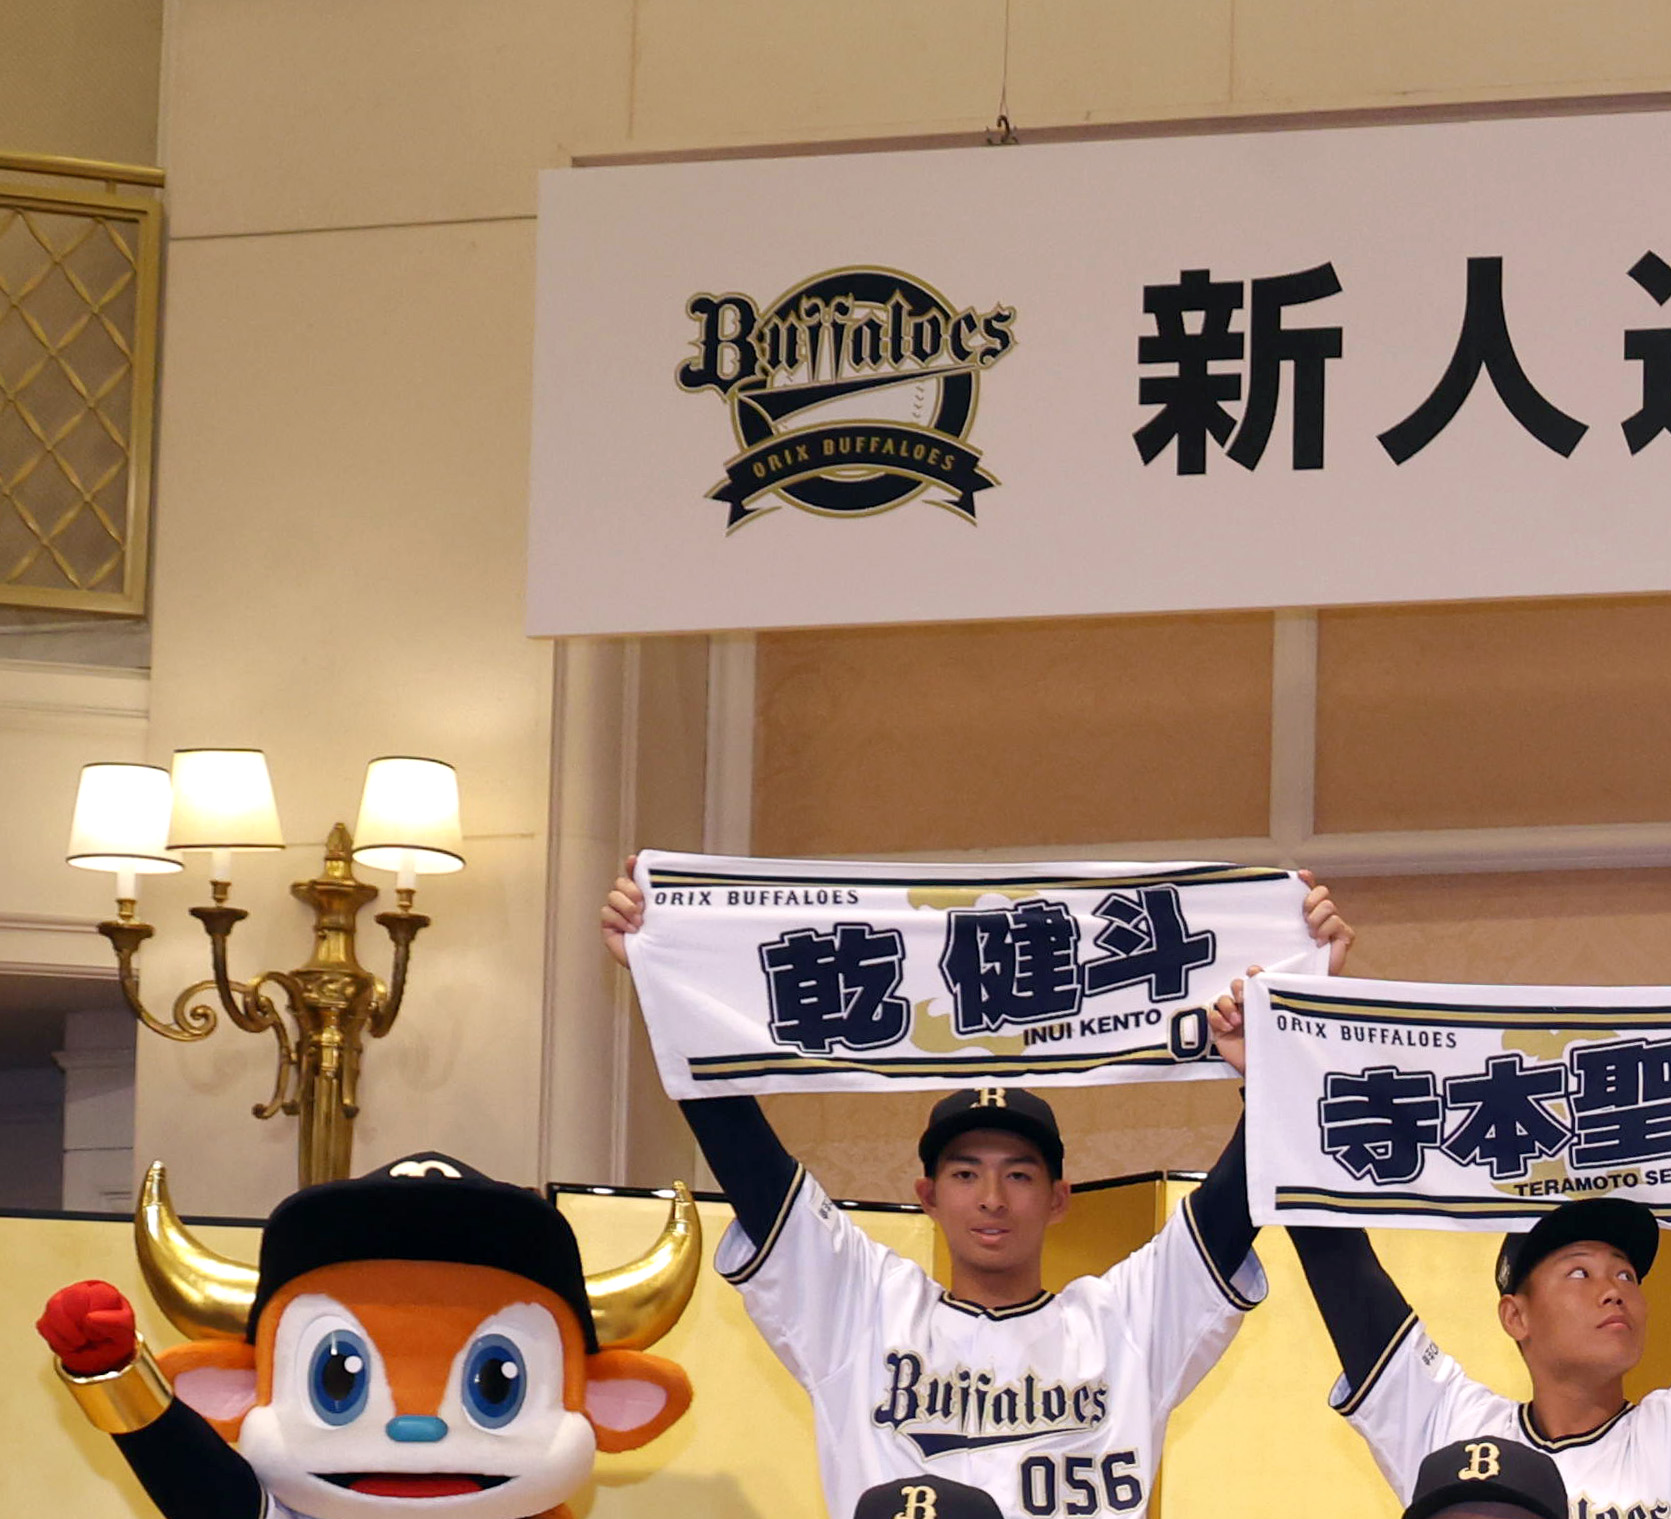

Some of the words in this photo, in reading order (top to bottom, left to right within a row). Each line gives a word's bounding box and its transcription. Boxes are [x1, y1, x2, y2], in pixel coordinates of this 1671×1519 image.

[675, 288, 1019, 404] Buffaloes
[752, 445, 810, 479] ORIX
[822, 435, 956, 471] BUFFALOES
[653, 892, 712, 907] ORIX
[726, 888, 860, 907] BUFFALOES
[1022, 1022, 1077, 1046] INUI
[1078, 1008, 1163, 1039] KENTO
[1276, 1014, 1328, 1040] ORIX
[1340, 1023, 1458, 1049] BUFFALOES
[1512, 1171, 1640, 1199] TERAMOTO
[873, 1348, 1110, 1438] Buffaloes
[1457, 1443, 1501, 1481] B
[1018, 1449, 1146, 1519] 056
